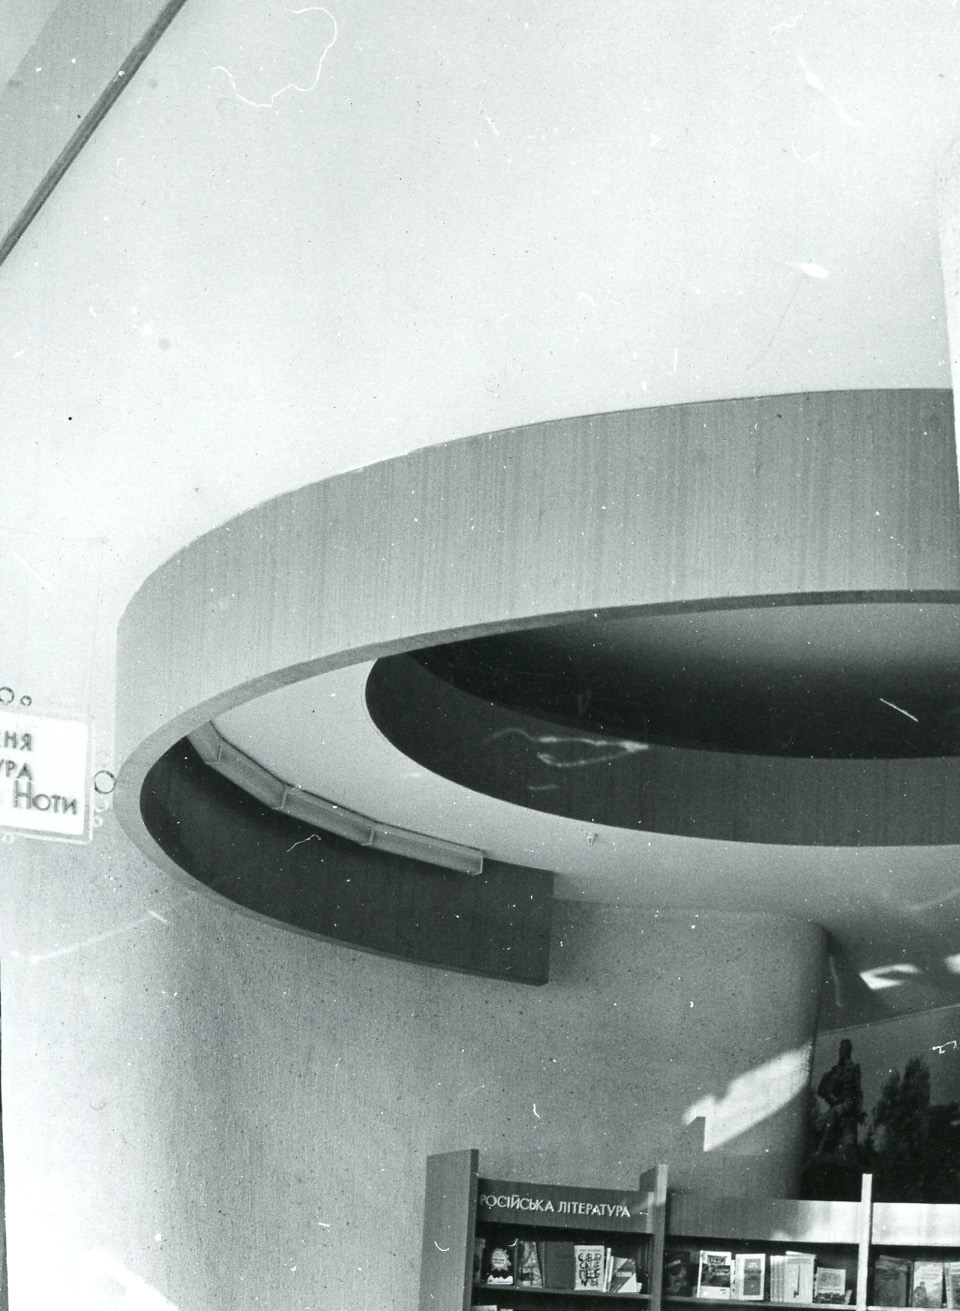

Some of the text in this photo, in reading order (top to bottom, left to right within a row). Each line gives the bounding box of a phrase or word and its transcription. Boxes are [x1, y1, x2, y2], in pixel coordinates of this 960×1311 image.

[13, 780, 79, 816] НОТИ
[480, 1193, 631, 1218] РОСІЙСЬКА ЛІТЕРАТУРА
